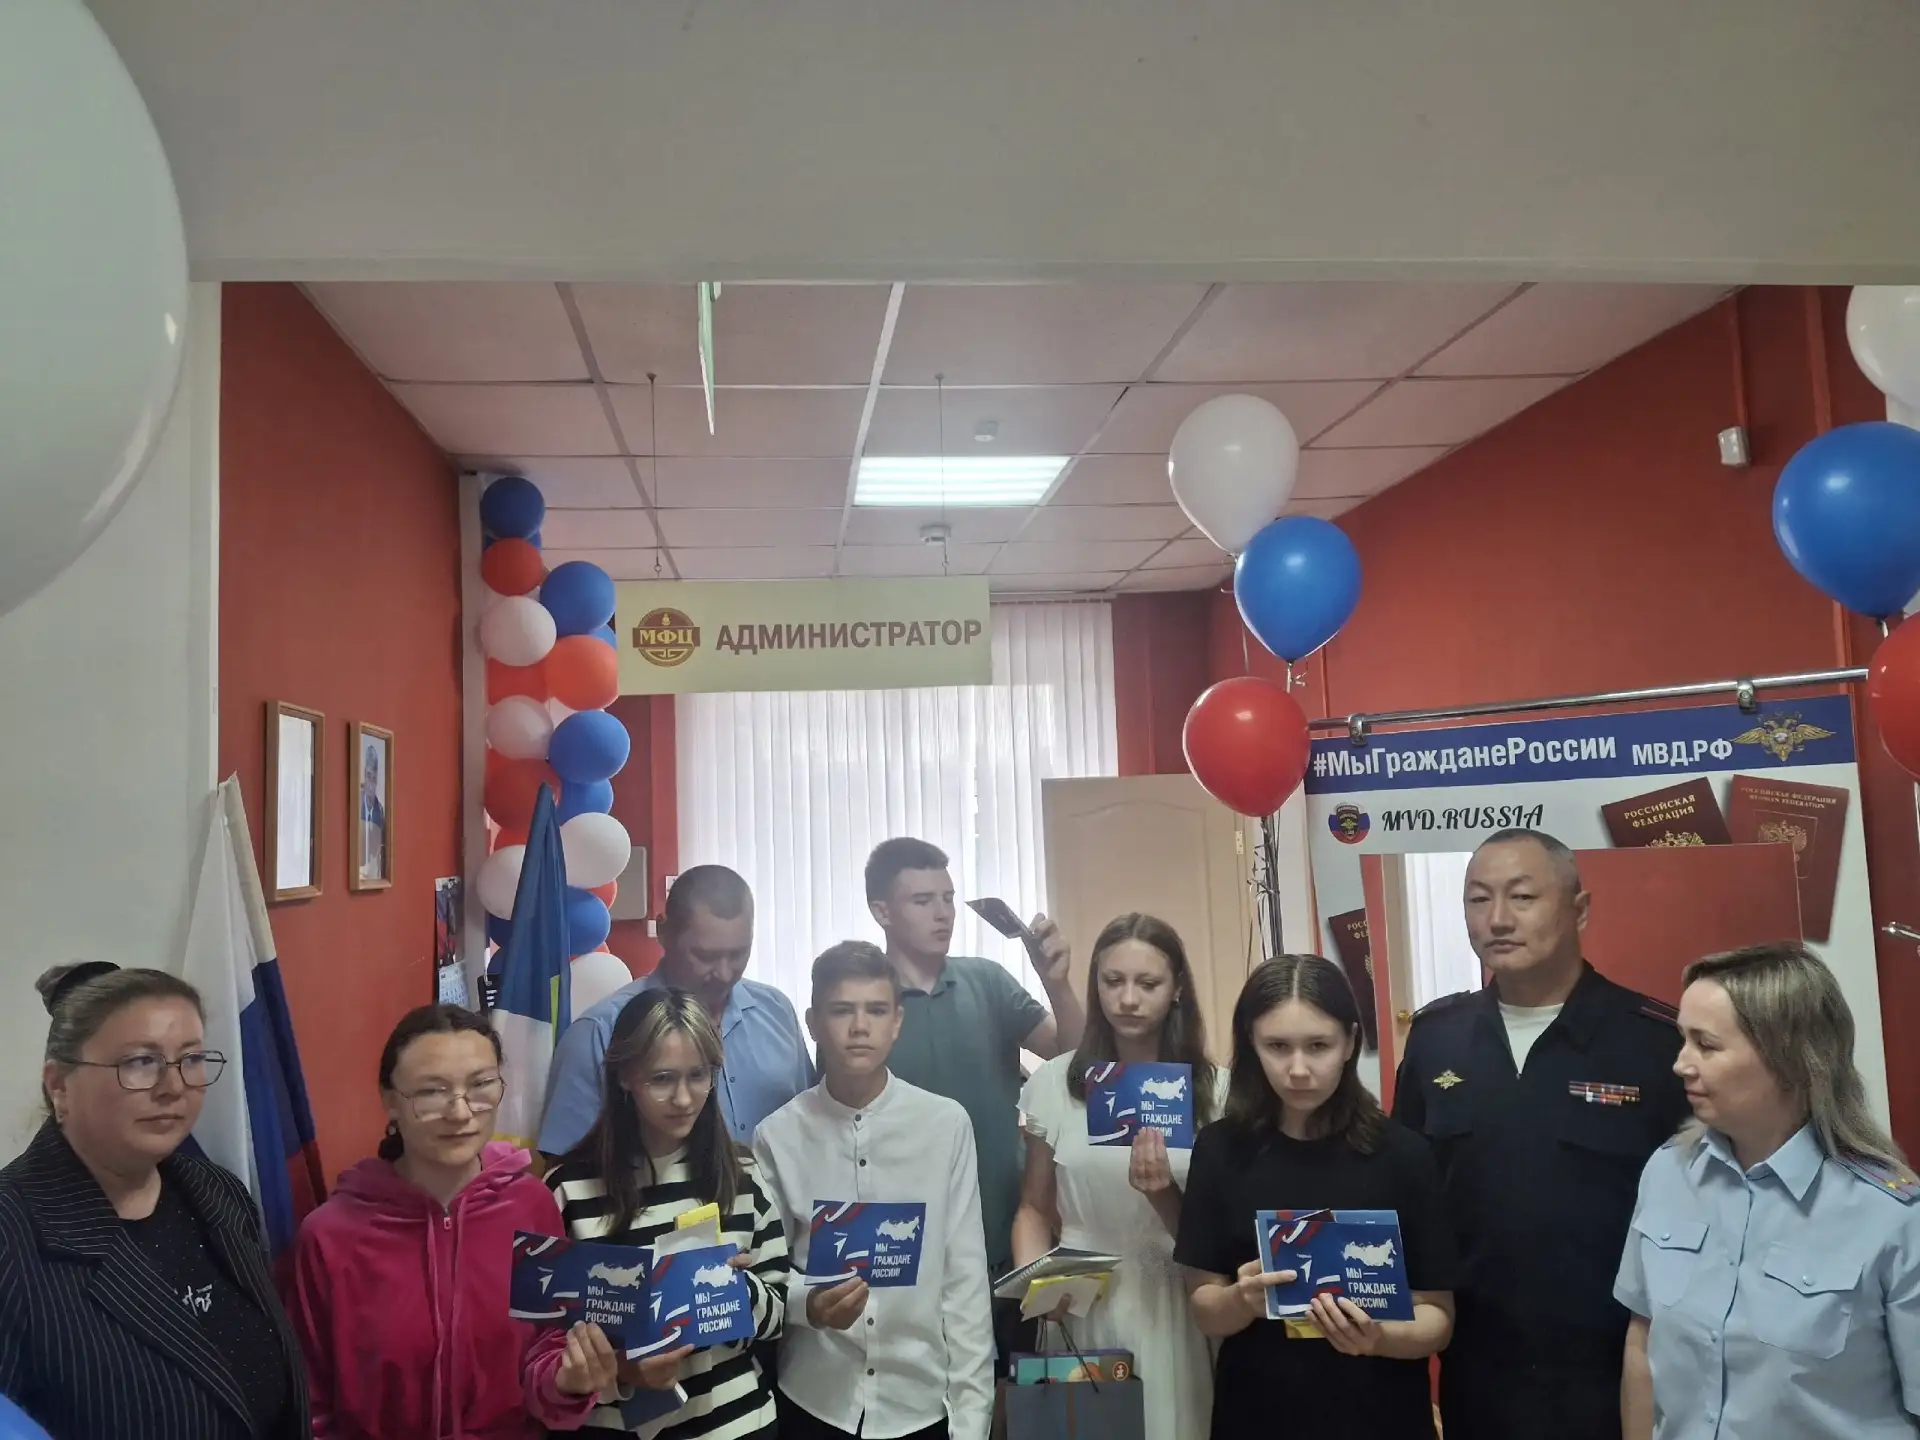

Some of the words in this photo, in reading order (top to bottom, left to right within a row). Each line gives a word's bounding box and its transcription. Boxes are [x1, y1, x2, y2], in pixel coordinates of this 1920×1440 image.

[639, 628, 694, 648] МФЦ
[715, 619, 982, 655] АДМИНИСТРАТОР
[1313, 736, 1617, 778] #МыГражданеРоссии
[1632, 738, 1733, 767] МВД.РФ
[1624, 794, 1696, 820] РОССИЙСКАЯ
[1381, 804, 1544, 831] MVD.RUSSIA
[1632, 805, 1695, 829] ФЕДЕРАЦИЯ
[1140, 1100, 1155, 1111] МЫ
[1141, 1113, 1183, 1125] ГРАЖДАНЕ
[874, 1242, 889, 1253] МЫ
[873, 1254, 912, 1266] ГРАЖДАНЕ
[1345, 1267, 1362, 1279] МЫ
[587, 1285, 604, 1296] МЫ
[1348, 1282, 1398, 1295] ГРАЖДАНЕ
[694, 1292, 711, 1305] МЫ
[586, 1298, 637, 1314] ГРАЖДАНЕ
[696, 1299, 741, 1319] ГРАЖДАНЕ
